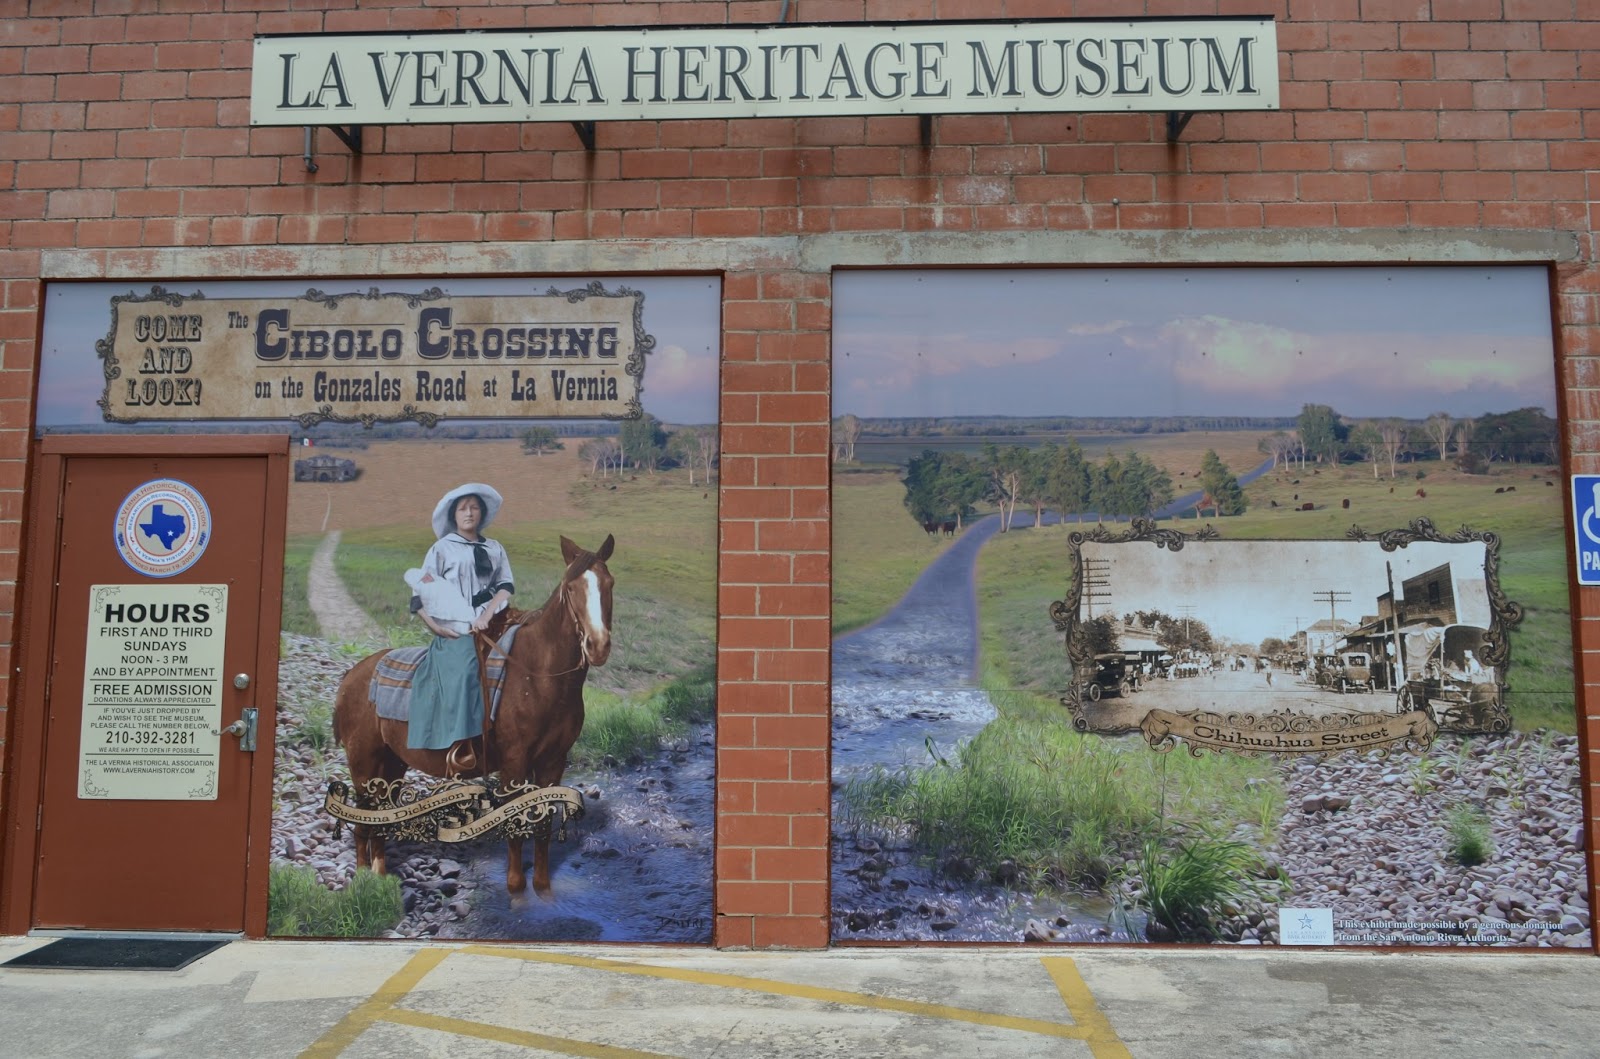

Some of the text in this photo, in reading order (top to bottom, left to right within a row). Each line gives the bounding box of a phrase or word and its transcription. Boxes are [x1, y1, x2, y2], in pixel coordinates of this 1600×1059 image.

[276, 36, 1260, 110] LA VERNIA HERITAGE MUSEUM
[134, 314, 202, 343] COME
[228, 307, 619, 362] The CIBOLO CROSSING
[138, 347, 193, 374] AND
[125, 377, 203, 407] LOOK!
[254, 370, 618, 402] on the Gonzales Road at La Vernia
[104, 604, 210, 624] HOURS
[100, 627, 212, 637] FIRST AND THIRD
[124, 641, 187, 652] SUNDAYS
[121, 656, 152, 664] NOON
[162, 656, 168, 664] 3
[172, 656, 188, 664] PM
[93, 668, 215, 676] AND BY APPOINTMENT
[94, 684, 212, 696] FREE ADMISSION
[106, 730, 195, 744] 210-392-3281
[1193, 726, 1389, 748] Chihuahua Street
[328, 791, 465, 823] Susanna Dickinson
[456, 792, 567, 841] Alamo Survivor
[1340, 920, 1358, 929] This
[1360, 920, 1392, 929] exhibit
[1394, 920, 1419, 929] made
[1420, 920, 1456, 930] possible
[1459, 921, 1471, 931] by
[1480, 922, 1520, 931] generous
[1523, 921, 1563, 929] donation
[1340, 933, 1511, 944] from the San Antonio River Authority.
